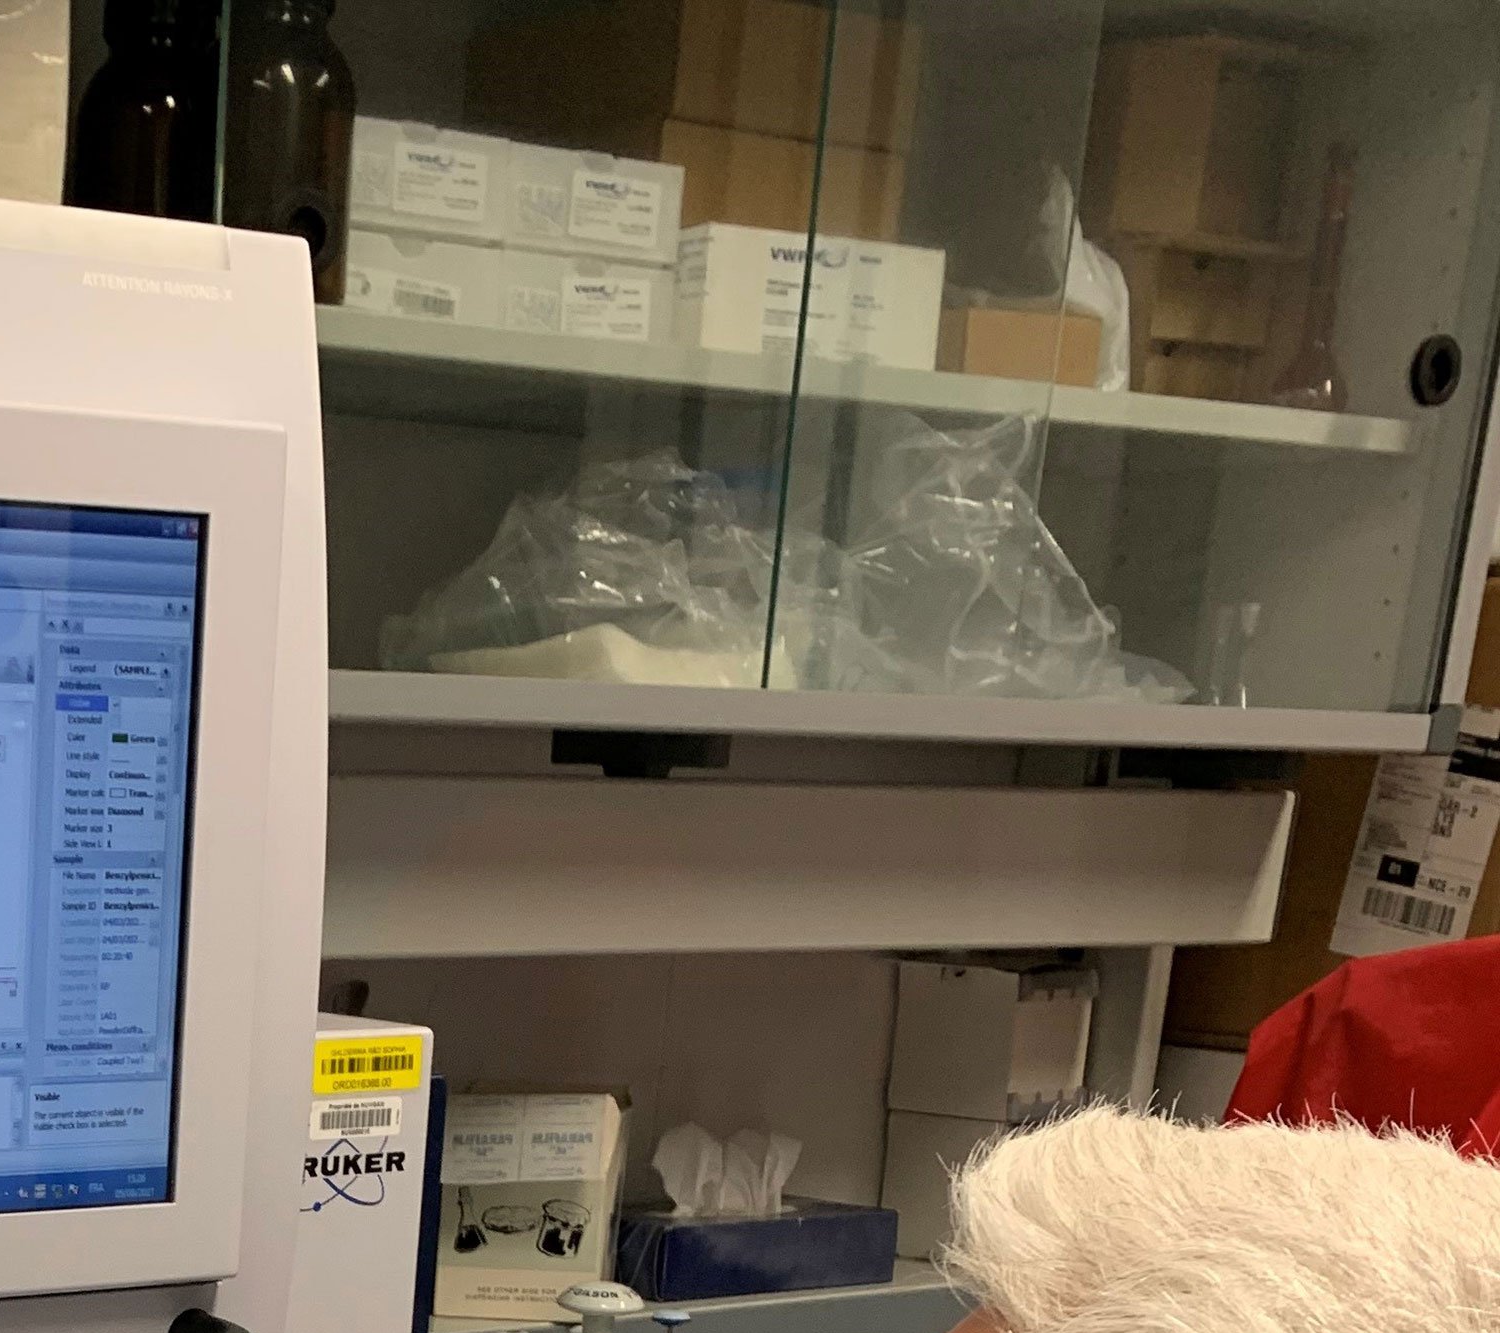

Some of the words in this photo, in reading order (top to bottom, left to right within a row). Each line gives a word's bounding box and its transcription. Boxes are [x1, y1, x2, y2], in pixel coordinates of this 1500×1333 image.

[82, 270, 160, 294] ATTENTION
[130, 735, 156, 744] Green
[107, 806, 145, 816] Diamond
